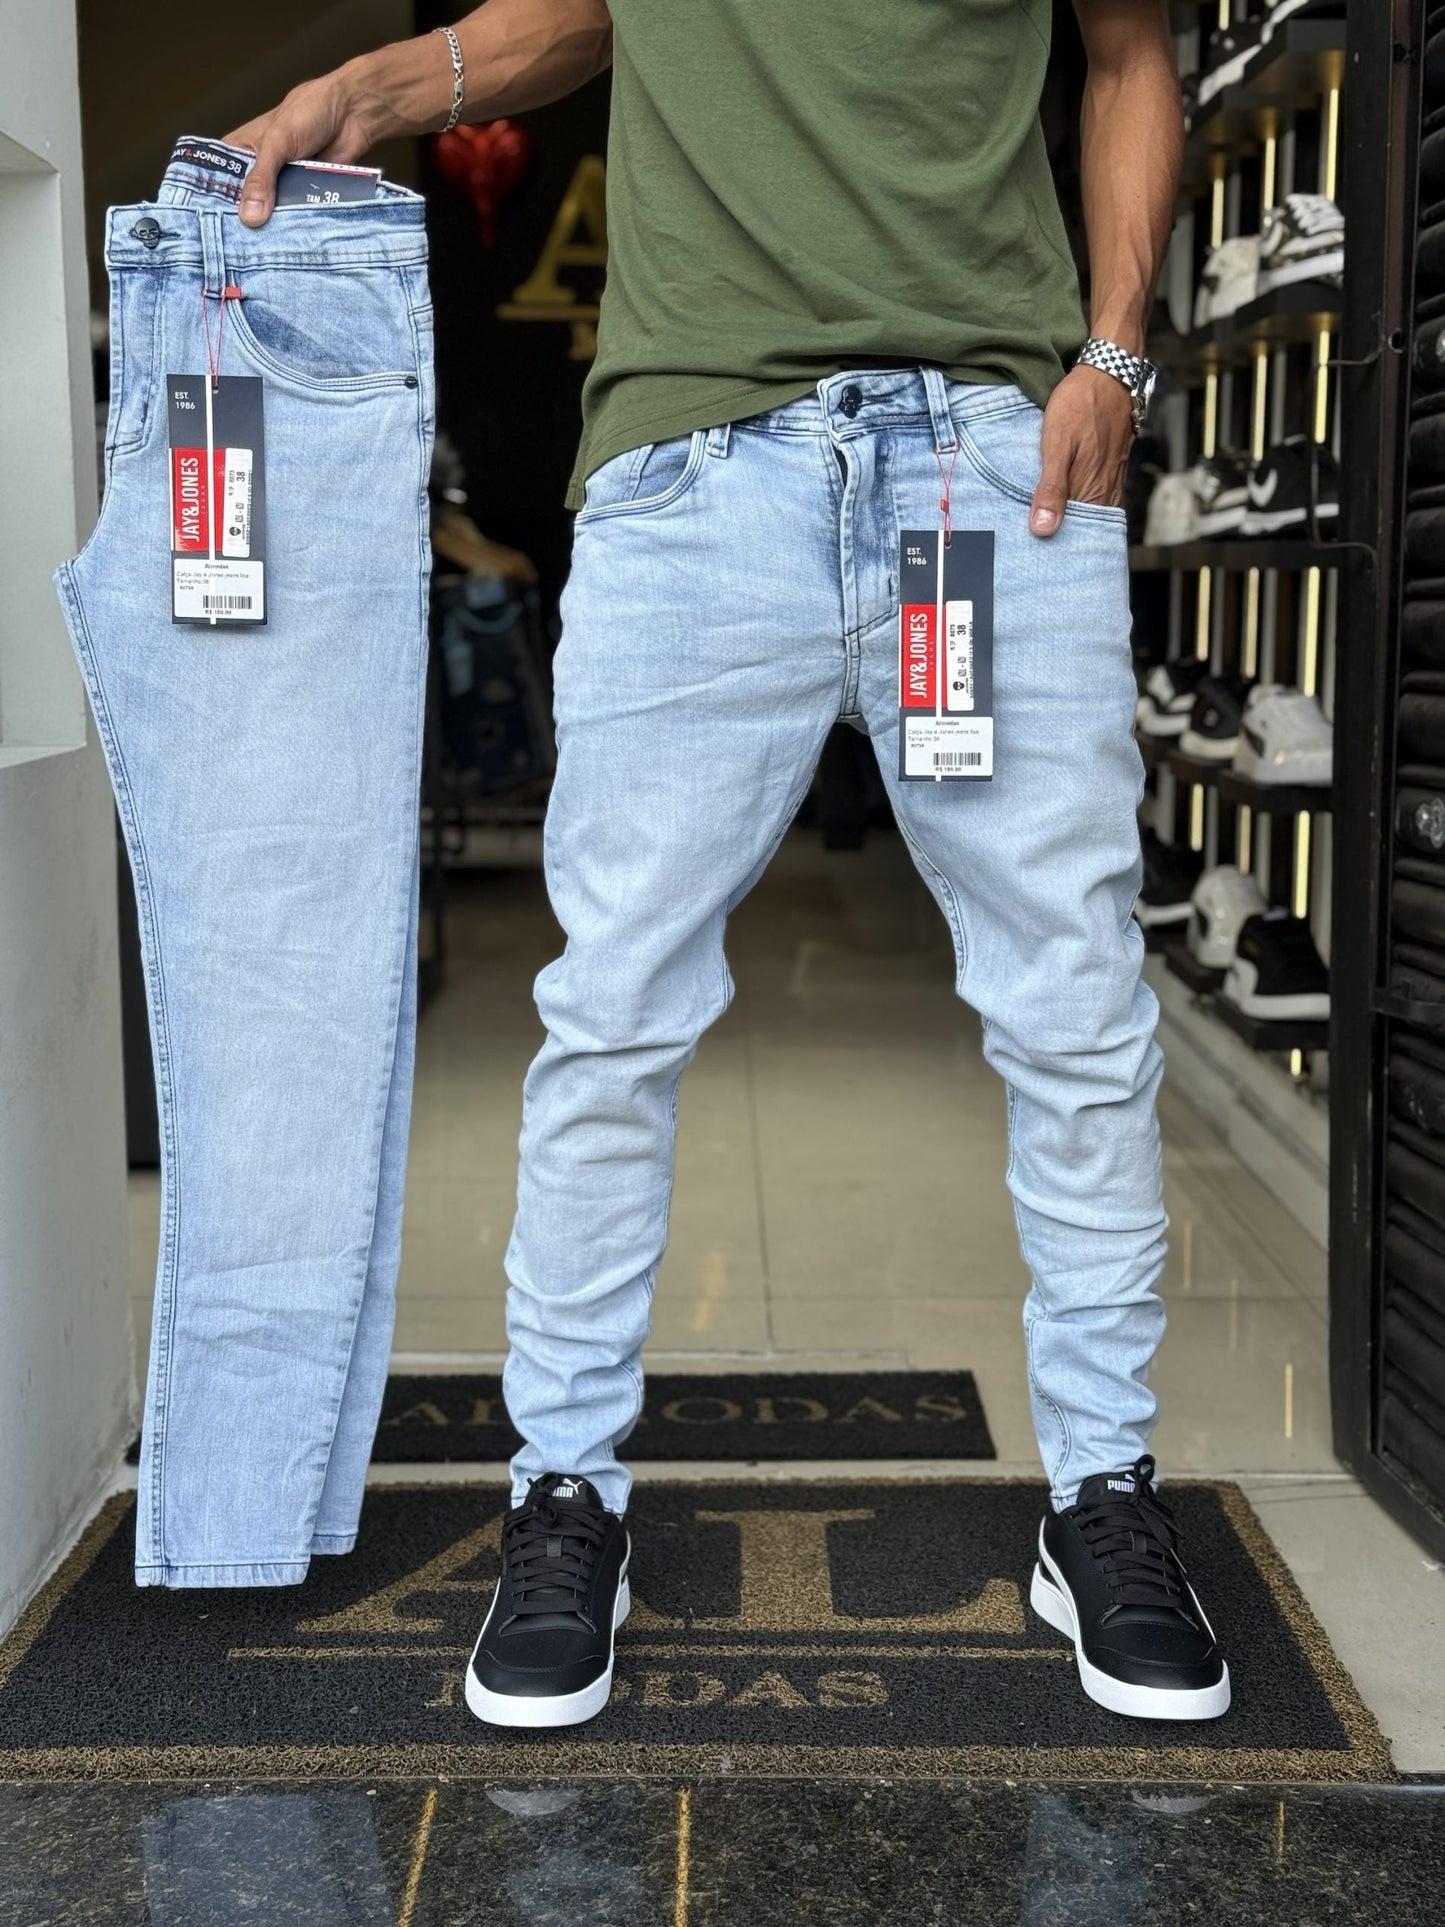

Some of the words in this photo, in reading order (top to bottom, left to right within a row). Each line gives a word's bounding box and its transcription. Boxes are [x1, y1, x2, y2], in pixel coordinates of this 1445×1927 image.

[193, 150, 227, 167] JONES
[227, 160, 242, 174] 38
[322, 191, 340, 204] 38
[174, 391, 190, 400] EST.
[175, 401, 196, 410] 1986
[236, 471, 246, 482] 38
[180, 457, 200, 542] JAY&JONES
[906, 547, 922, 556] EST.
[907, 557, 927, 566] 1986
[957, 624, 967, 636] 38
[909, 613, 928, 698] JAY&JONES
[640, 1395, 968, 1425] ODAS
